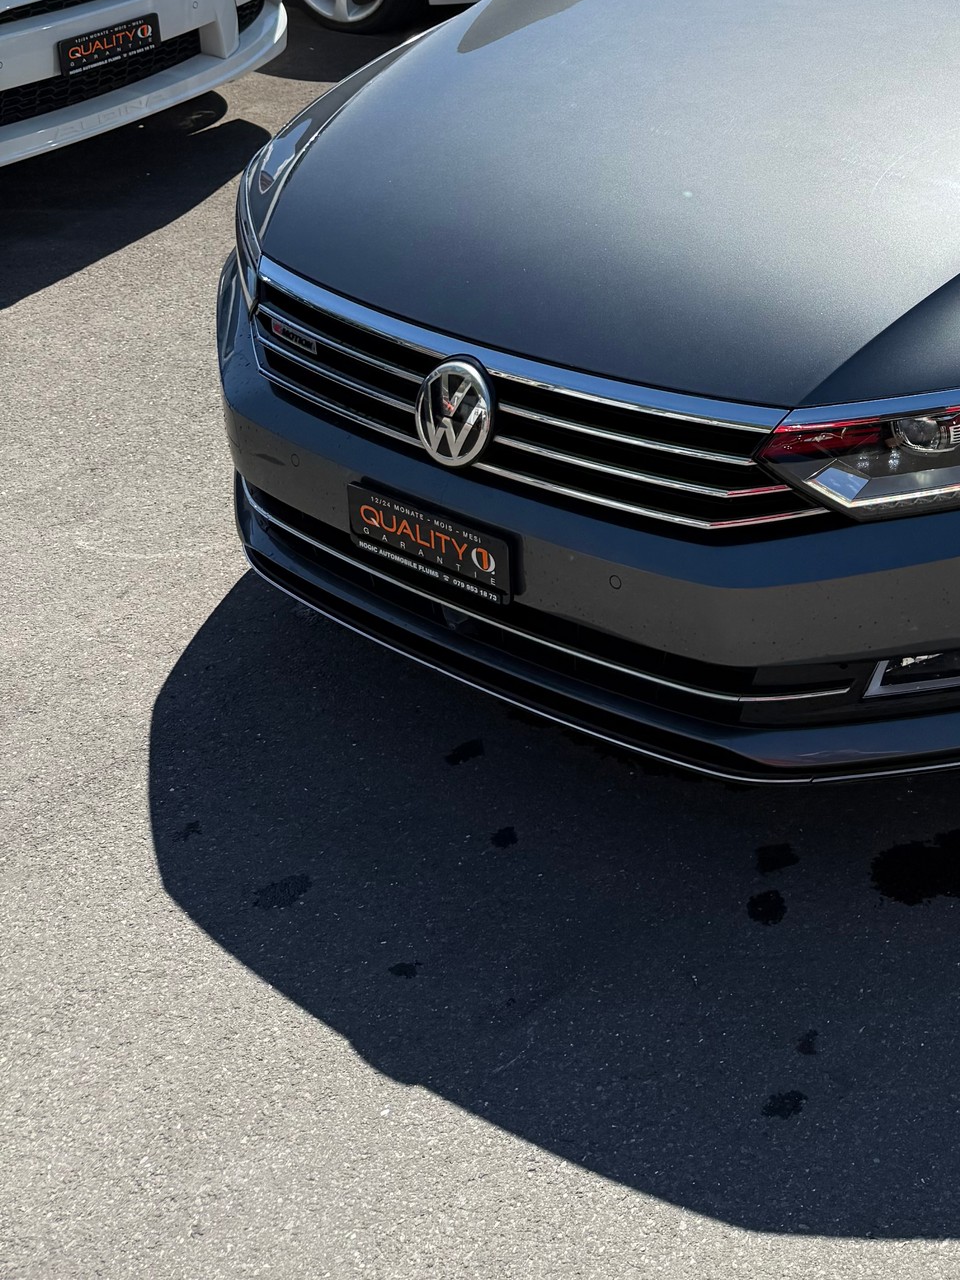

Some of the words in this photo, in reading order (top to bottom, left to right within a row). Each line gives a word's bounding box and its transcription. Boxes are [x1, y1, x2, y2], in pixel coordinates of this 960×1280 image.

[68, 28, 136, 59] QUALITY
[359, 504, 468, 561] QUALITY
[370, 496, 391, 508] 12/24
[393, 504, 424, 521] MONATE
[434, 519, 453, 533] MOIS
[462, 531, 482, 544] MESI
[363, 527, 496, 586] GARANTIE
[378, 549, 417, 570] AUTOMOBILE
